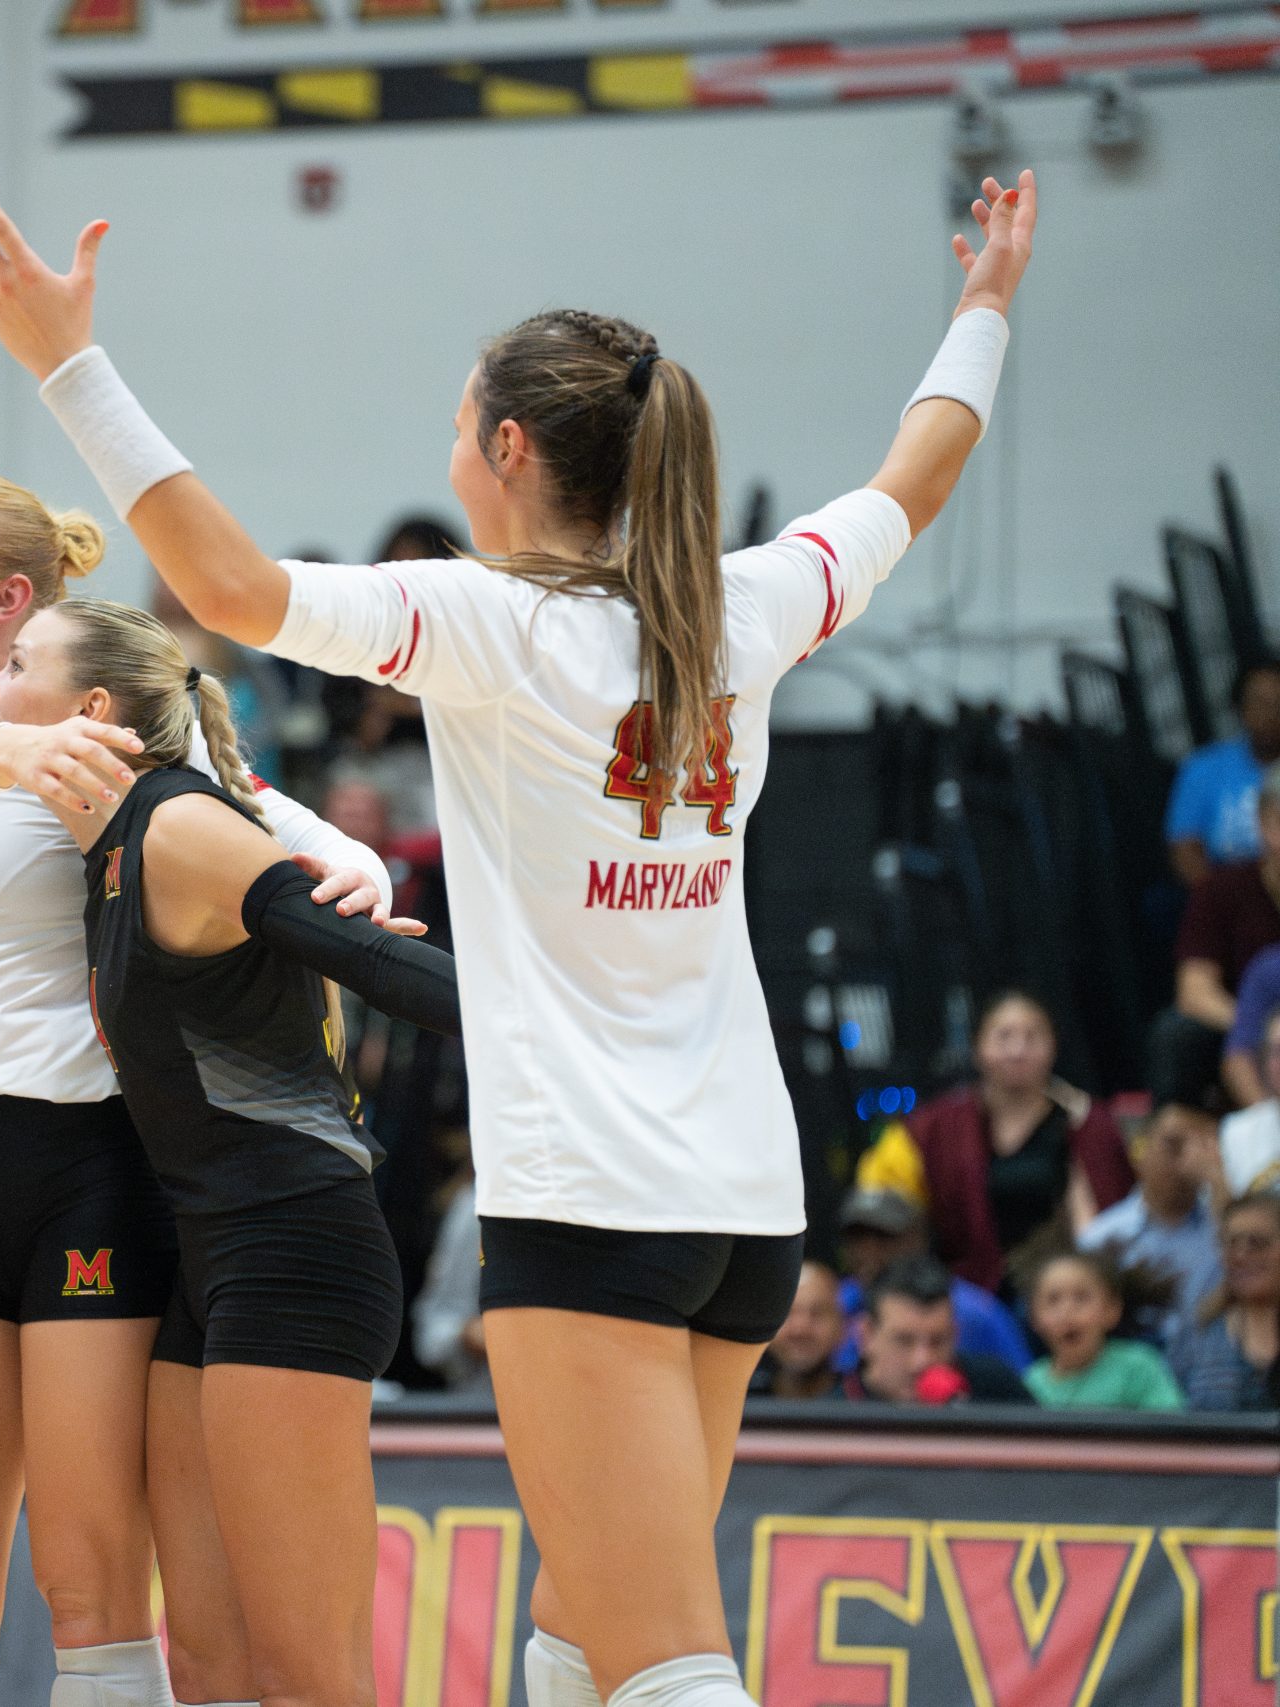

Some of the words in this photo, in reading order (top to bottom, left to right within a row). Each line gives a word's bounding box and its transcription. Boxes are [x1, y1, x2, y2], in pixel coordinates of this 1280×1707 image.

[604, 693, 739, 840] 44
[584, 859, 732, 911] MARYLAND
[63, 1248, 113, 1290] M
